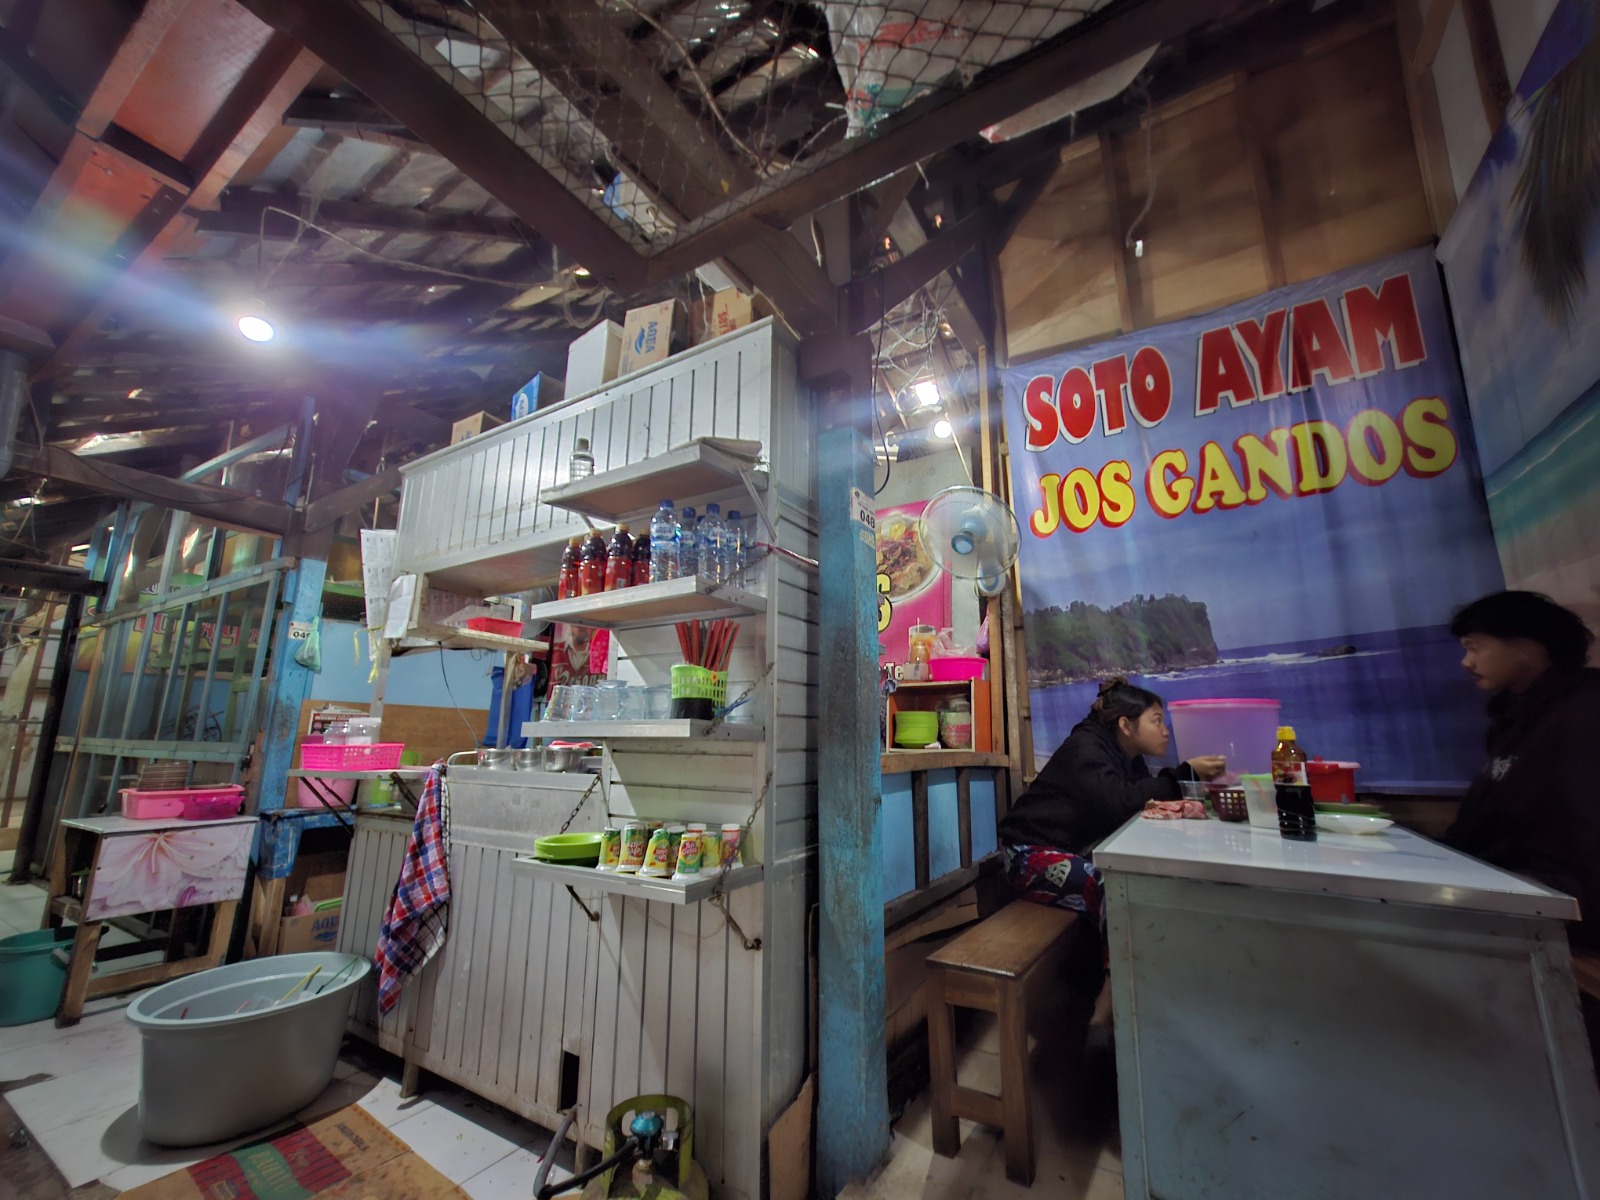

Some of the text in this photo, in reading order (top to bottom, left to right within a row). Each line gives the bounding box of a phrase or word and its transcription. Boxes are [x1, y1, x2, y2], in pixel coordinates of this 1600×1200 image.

[645, 321, 658, 353] AQUA
[1024, 273, 1428, 452] SOTO AYAM
[1030, 396, 1458, 539] JOS GANDOS
[860, 510, 876, 529] 048
[884, 661, 909, 681] Te
